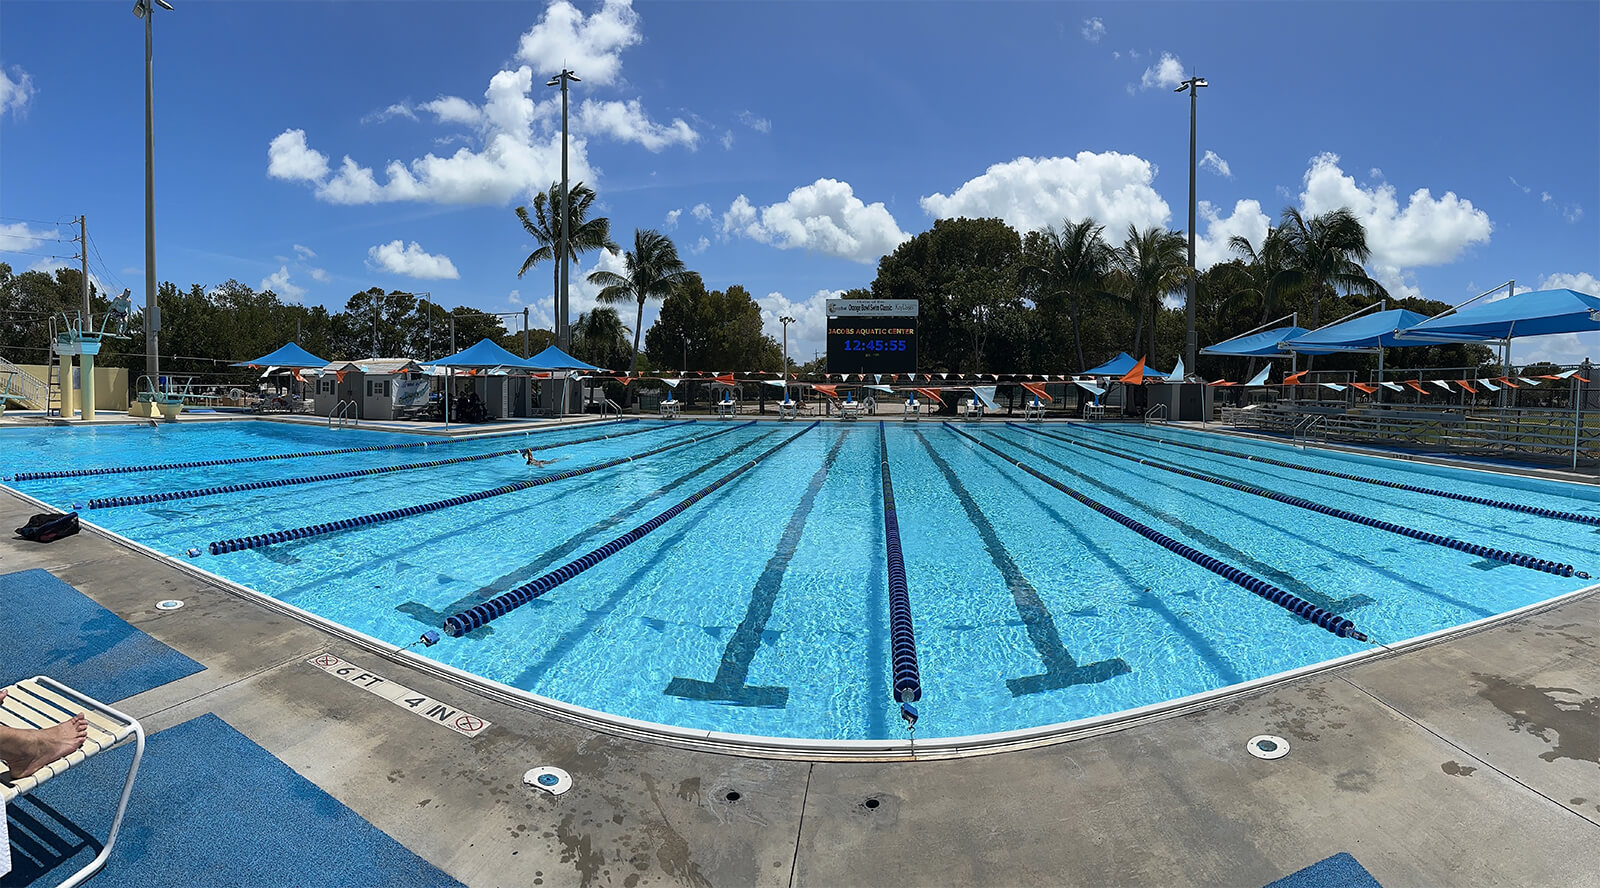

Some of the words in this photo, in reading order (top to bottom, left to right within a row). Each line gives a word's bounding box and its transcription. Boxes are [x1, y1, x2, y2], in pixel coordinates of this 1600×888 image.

[855, 328, 887, 336] AQUATIC
[844, 339, 906, 351] 12:45:55
[336, 667, 355, 676] 6
[352, 673, 384, 687] FT
[404, 697, 427, 708] 4
[425, 704, 456, 722] IN
